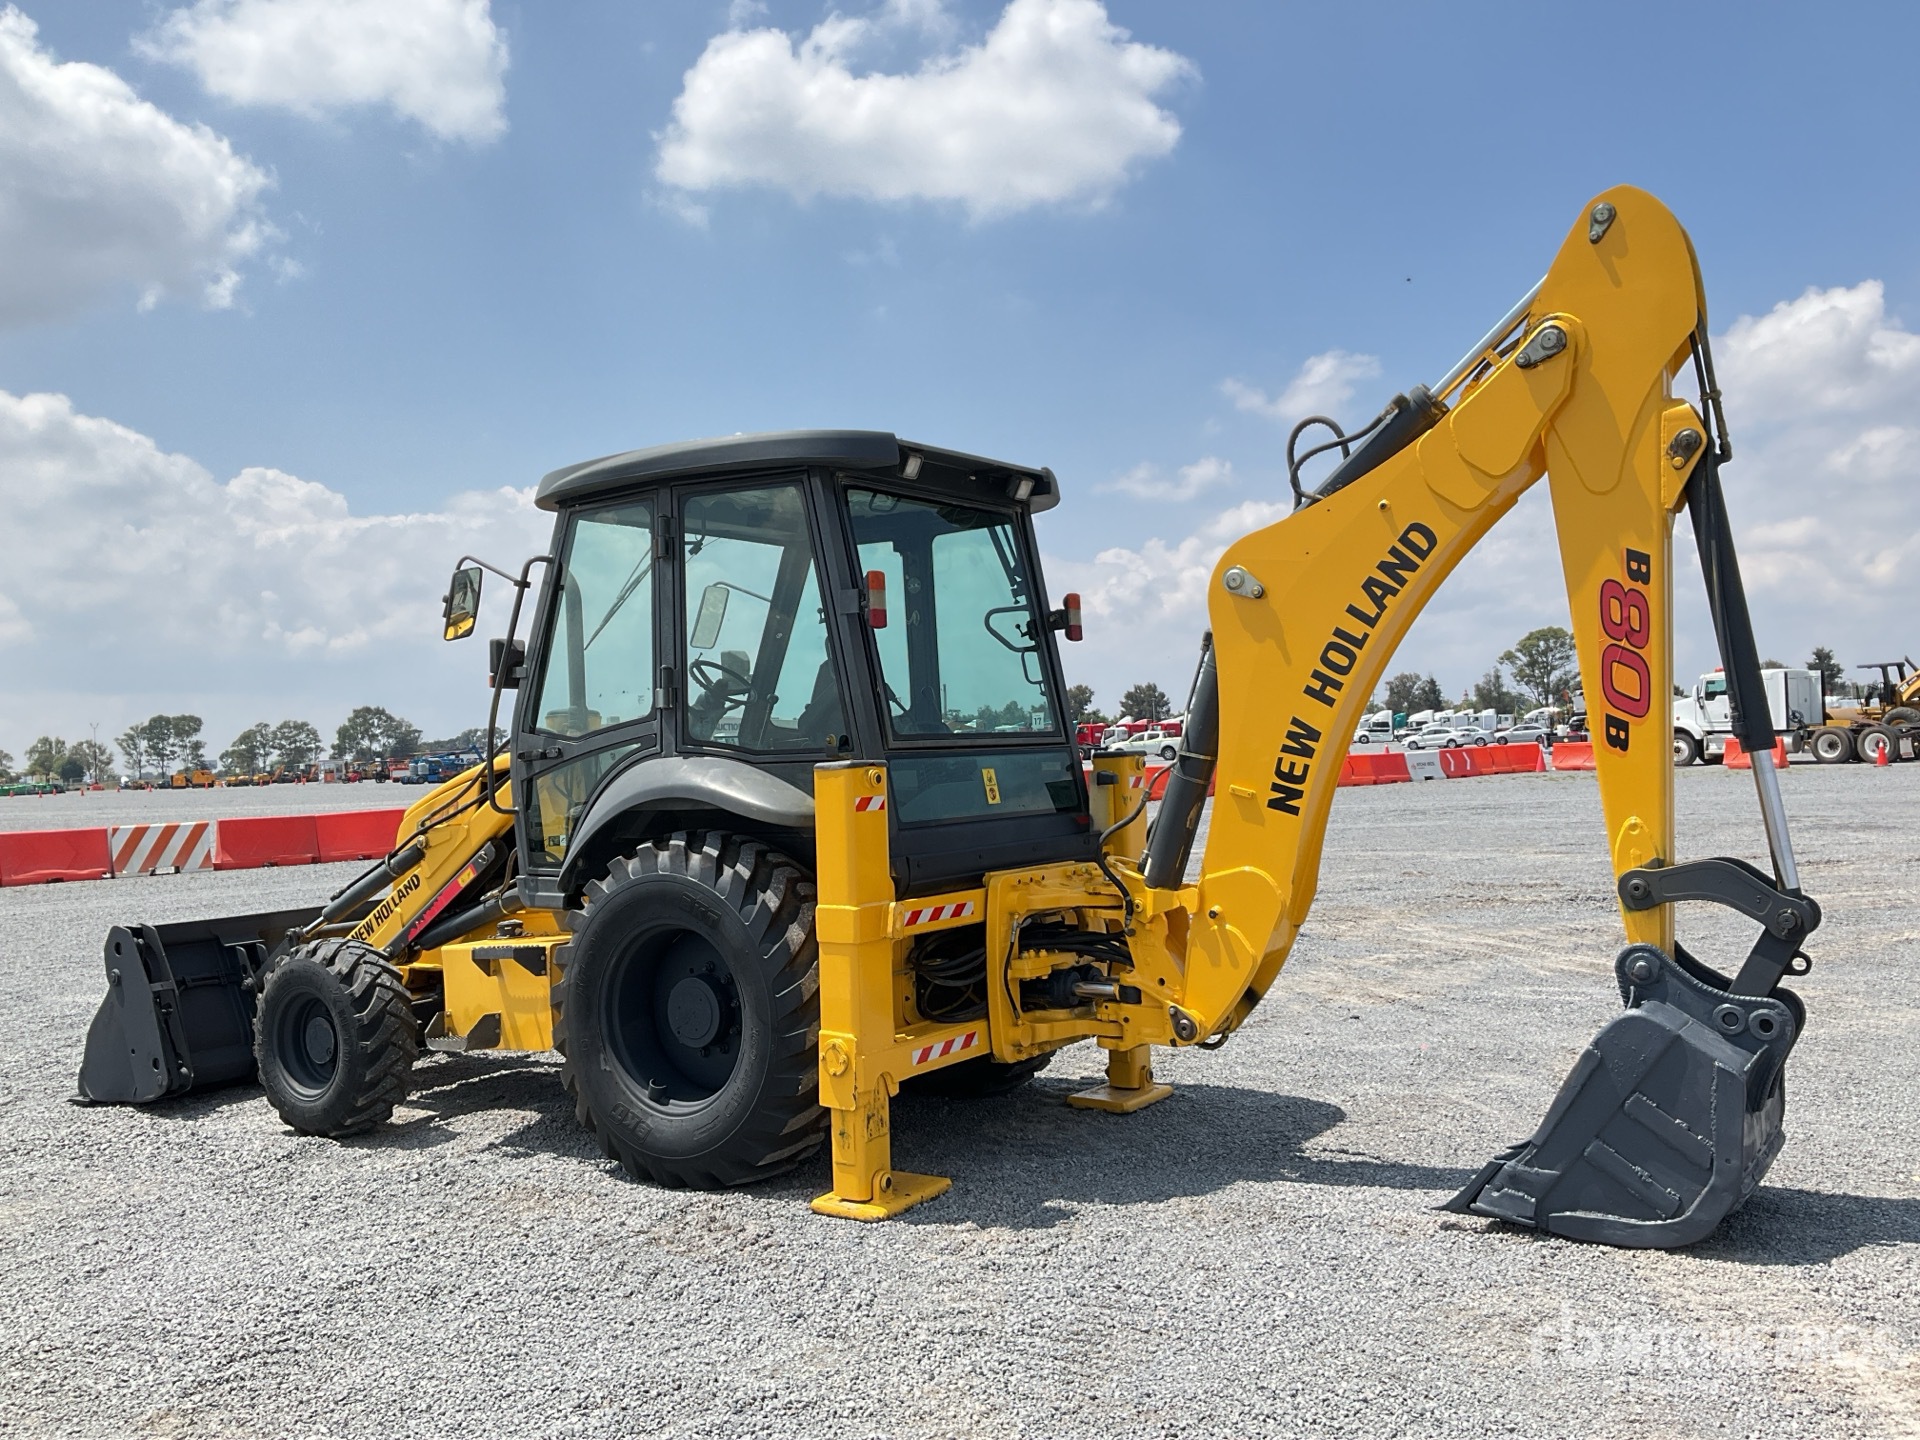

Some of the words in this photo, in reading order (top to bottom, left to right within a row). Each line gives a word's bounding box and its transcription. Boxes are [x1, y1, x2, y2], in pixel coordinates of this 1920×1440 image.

[1267, 715, 1322, 816] NEW
[1302, 522, 1438, 708] HOLLAND
[1033, 717, 1041, 725] 17
[351, 922, 375, 940] NEW
[373, 873, 420, 927] HOLLAND
